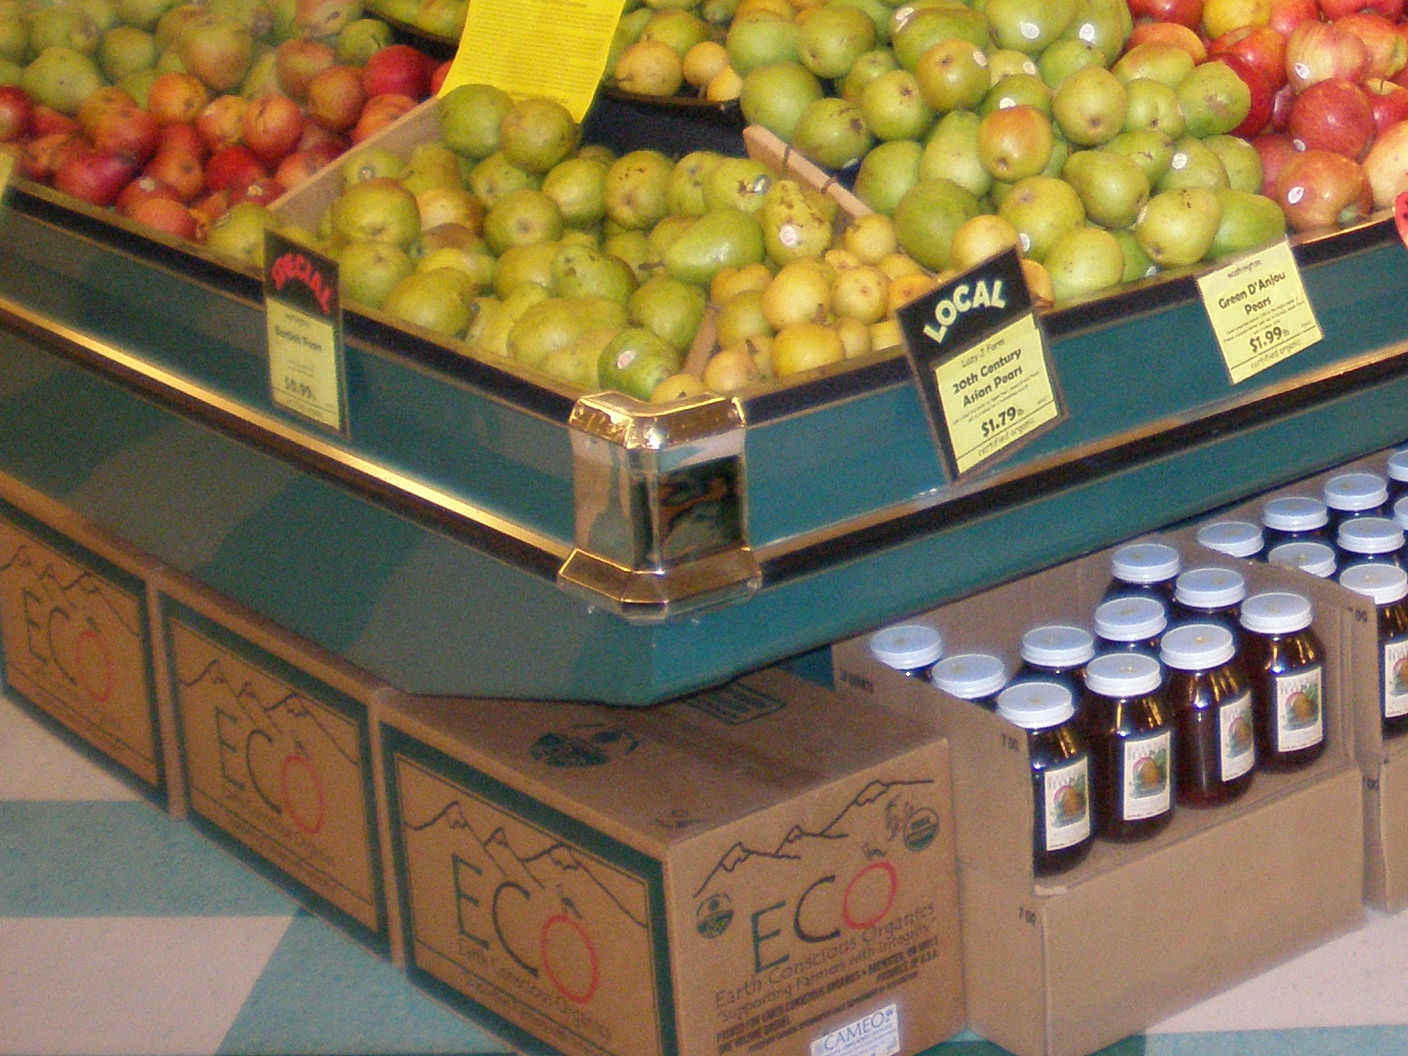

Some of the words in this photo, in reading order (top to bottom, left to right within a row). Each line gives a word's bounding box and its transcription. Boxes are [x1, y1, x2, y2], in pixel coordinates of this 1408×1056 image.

[922, 279, 1007, 344] LOCAL
[1218, 288, 1249, 310] Green
[1246, 271, 1287, 296] D'Anjou
[1244, 295, 1272, 316] Pears
[1248, 325, 1283, 354] $1.99
[951, 371, 980, 395] 20th
[979, 347, 1023, 378] Century
[961, 382, 993, 408] Asian
[993, 365, 1024, 390] Pears
[980, 405, 1017, 438] $1.79
[23, 586, 116, 703] ECO
[214, 704, 324, 834] ECO
[450, 853, 599, 1005] ECO
[751, 859, 898, 975] ECO
[715, 974, 762, 1009] Earth
[767, 939, 857, 986] Conscious
[861, 903, 935, 944] Organics
[823, 1011, 885, 1051] CAMEO
